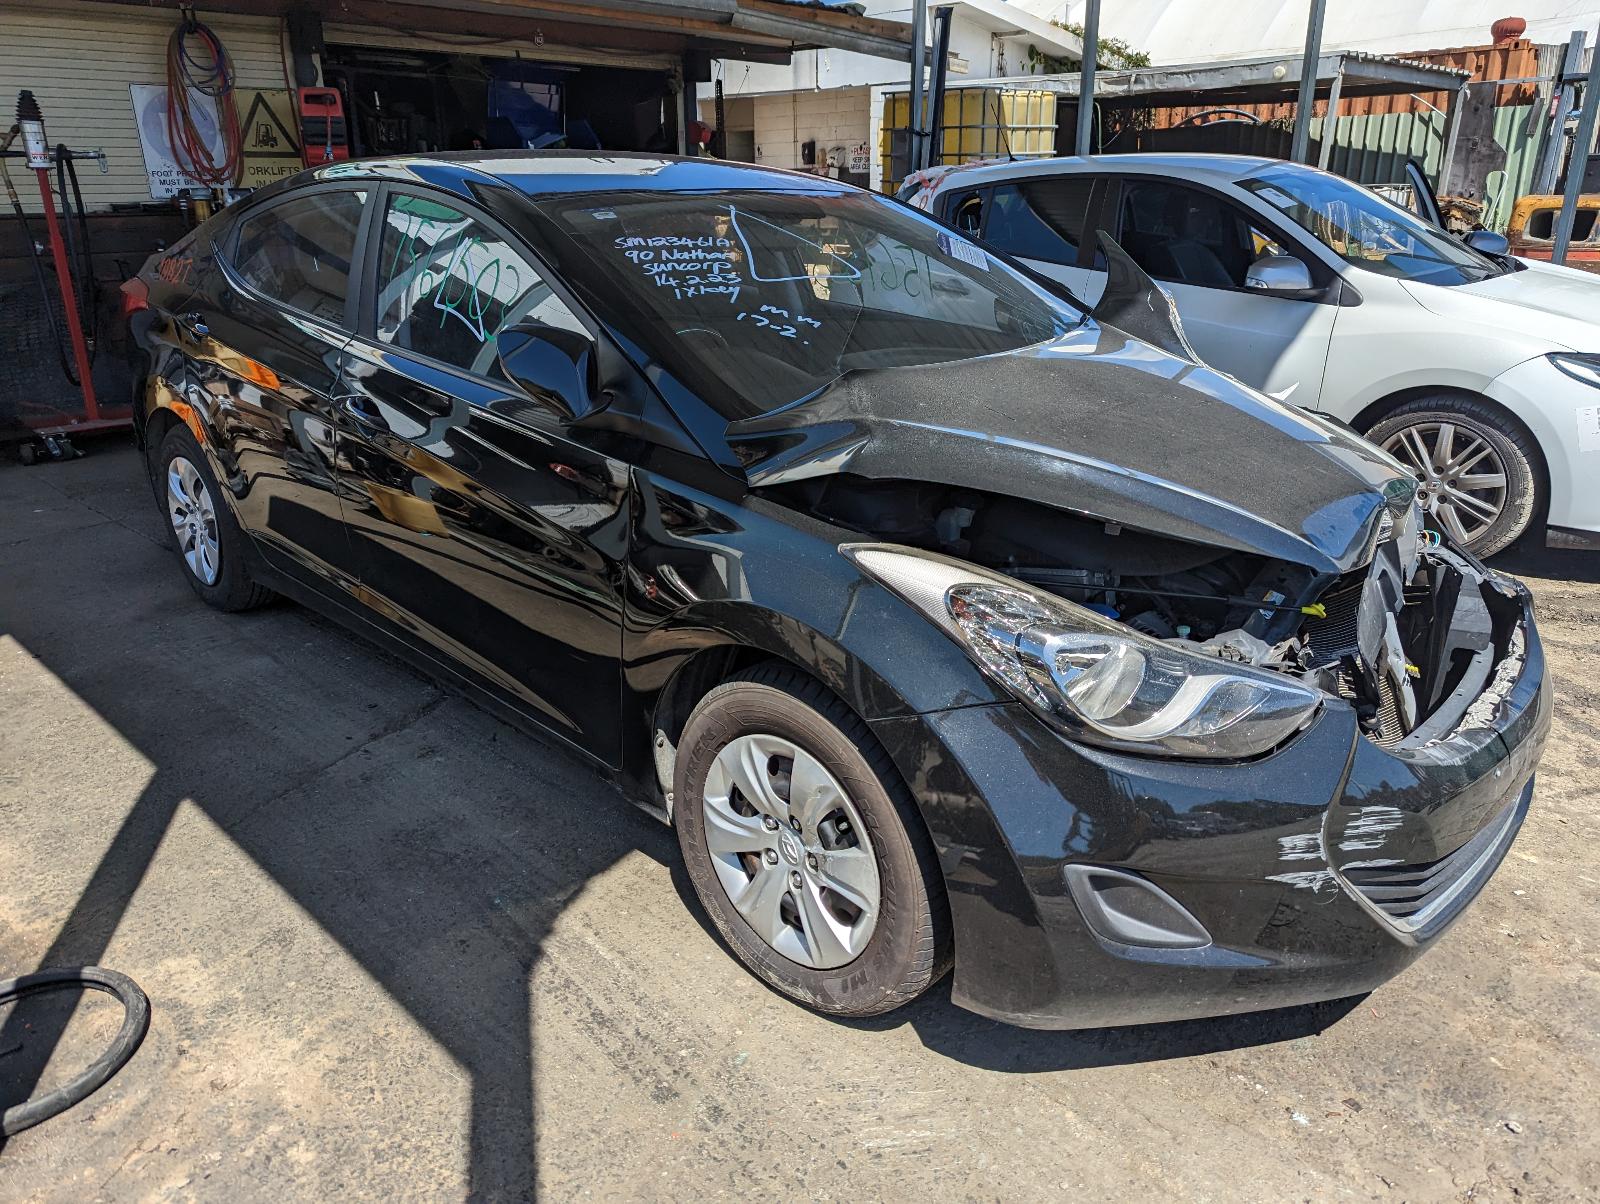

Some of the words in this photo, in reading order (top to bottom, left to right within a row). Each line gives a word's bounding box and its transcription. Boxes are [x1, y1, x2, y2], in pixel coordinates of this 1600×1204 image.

[249, 166, 300, 176] ORKLIFTS
[624, 249, 655, 264] 90
[661, 248, 737, 262] Nathan
